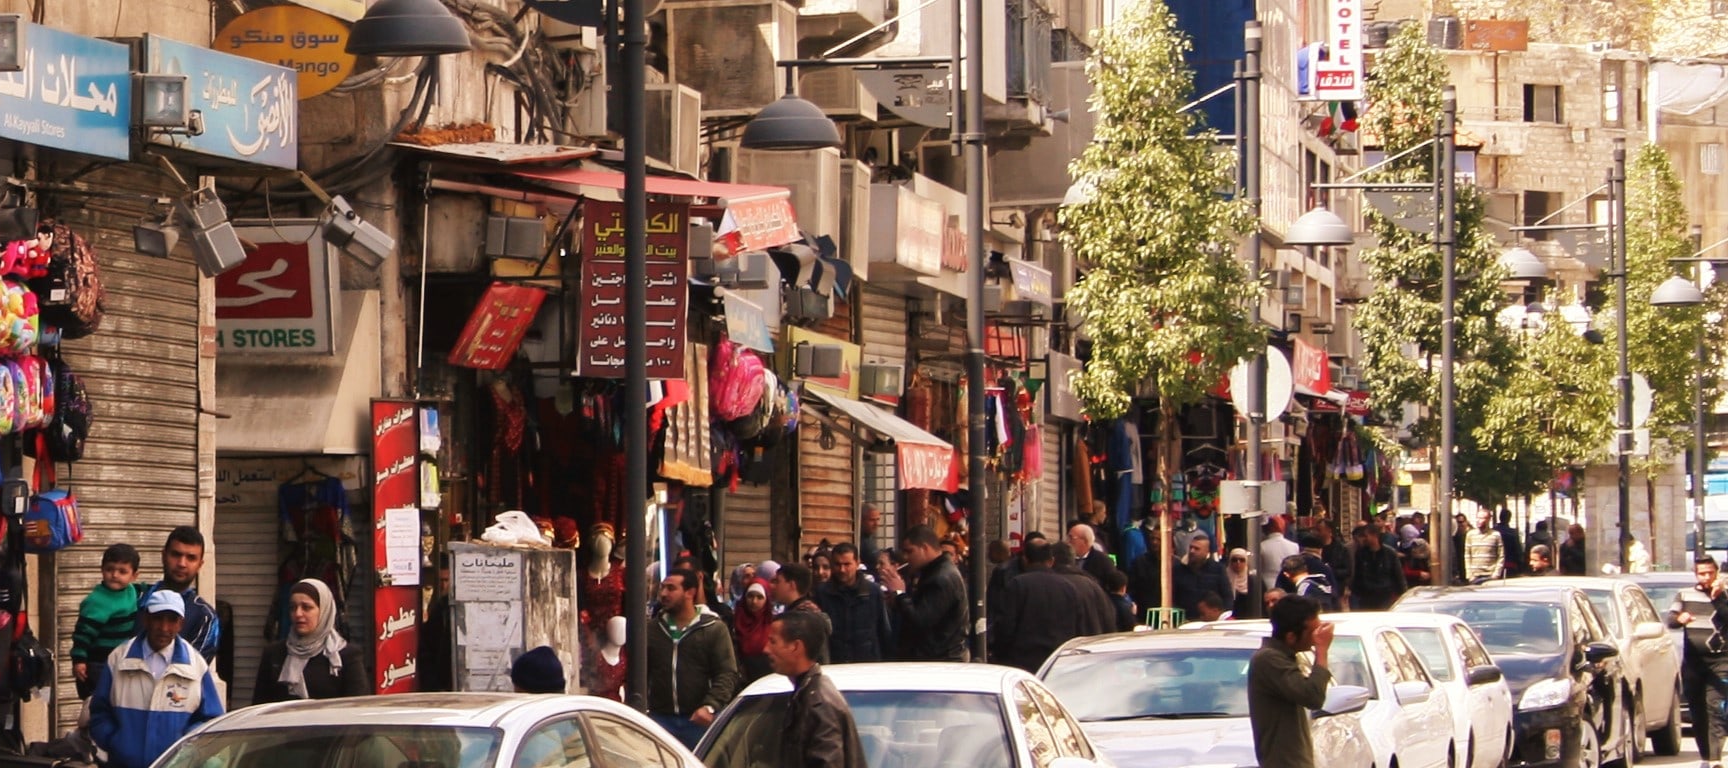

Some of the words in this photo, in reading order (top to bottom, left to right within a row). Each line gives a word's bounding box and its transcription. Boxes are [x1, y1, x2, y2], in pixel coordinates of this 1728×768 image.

[230, 29, 285, 49] منكو
[291, 30, 339, 49] سوق
[1338, 0, 1352, 65] OTEL
[40, 53, 117, 117] محلات
[1320, 74, 1353, 87] فندق
[645, 295, 677, 306] عط
[590, 313, 617, 328] دنانير
[232, 328, 317, 348] STORES
[590, 335, 609, 348] على
[590, 354, 625, 369] مجانا
[379, 606, 416, 640] عطور
[380, 652, 416, 689] بخور
